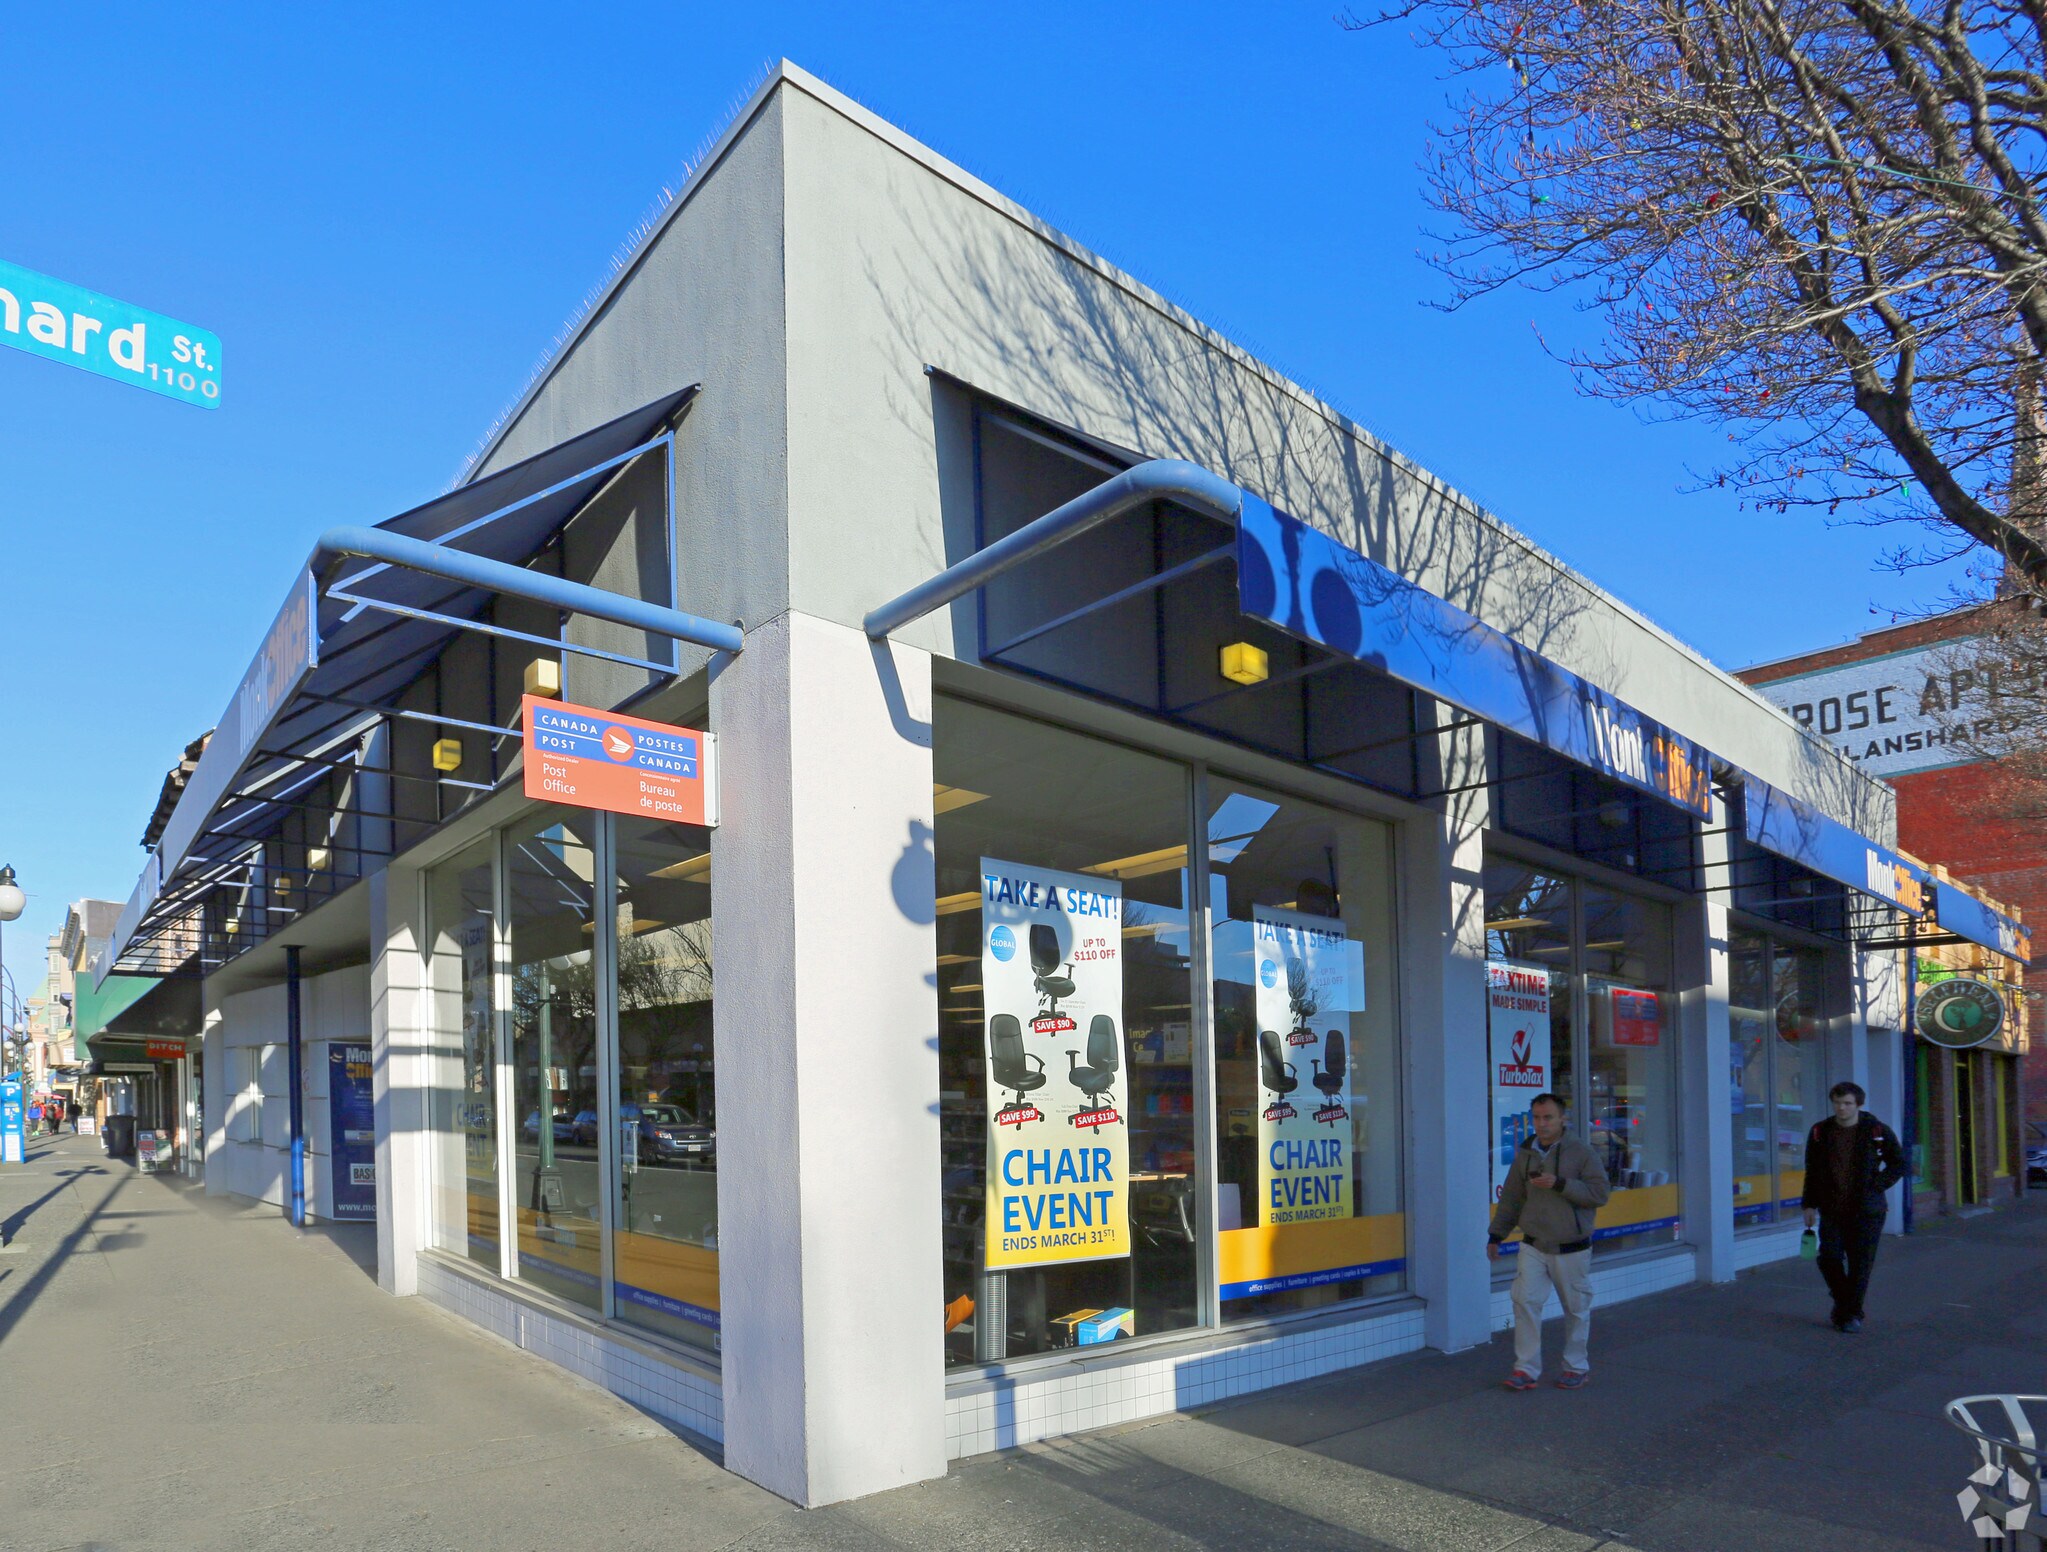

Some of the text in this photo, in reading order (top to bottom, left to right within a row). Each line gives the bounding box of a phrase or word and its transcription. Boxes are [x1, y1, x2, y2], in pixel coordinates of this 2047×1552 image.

[171, 335, 214, 371] St.
[147, 363, 219, 399] 1100
[1781, 685, 1897, 734] ROSE
[541, 715, 598, 735] CANADA
[542, 736, 576, 750] POST
[638, 735, 684, 752] POSTES
[1833, 717, 2020, 761] LANSHARD
[543, 763, 566, 778] Post
[639, 755, 690, 773] CANADA
[543, 779, 577, 795] Office
[640, 781, 675, 797] Bureau
[640, 796, 683, 813] de poste
[1866, 848, 1922, 912] Monk Office
[984, 875, 1118, 920] TAKE A SEAT!
[991, 938, 1016, 949] GLOBAL
[1083, 938, 1106, 948] UP TO
[1256, 919, 1345, 952] TAKE A SEAT!
[1074, 949, 1116, 962] $110 OFF
[1493, 994, 1547, 1013] MADE SIMPLE
[1036, 1019, 1070, 1031] SAVE $90
[1291, 1035, 1305, 1044] SAVE
[1501, 1066, 1542, 1085] TurboTax
[7, 1087, 15, 1097] P
[1001, 1109, 1036, 1123] SAVE $99
[1077, 1112, 1115, 1126] SAVE $110
[1268, 1109, 1281, 1120] SAVE
[1319, 1111, 1332, 1121] SAVE
[1269, 1139, 1343, 1171] CHAIR
[1002, 1147, 1113, 1186] CHAIR
[1270, 1174, 1343, 1209] EVENT
[1003, 1191, 1114, 1233] EVENT
[1270, 1211, 1293, 1224] ENDS
[1295, 1208, 1326, 1222] MARCH
[1002, 1236, 1037, 1251] ENDS
[1041, 1231, 1086, 1248] MARCH
[1248, 1283, 1263, 1293] office
[1263, 1280, 1282, 1291] supplies
